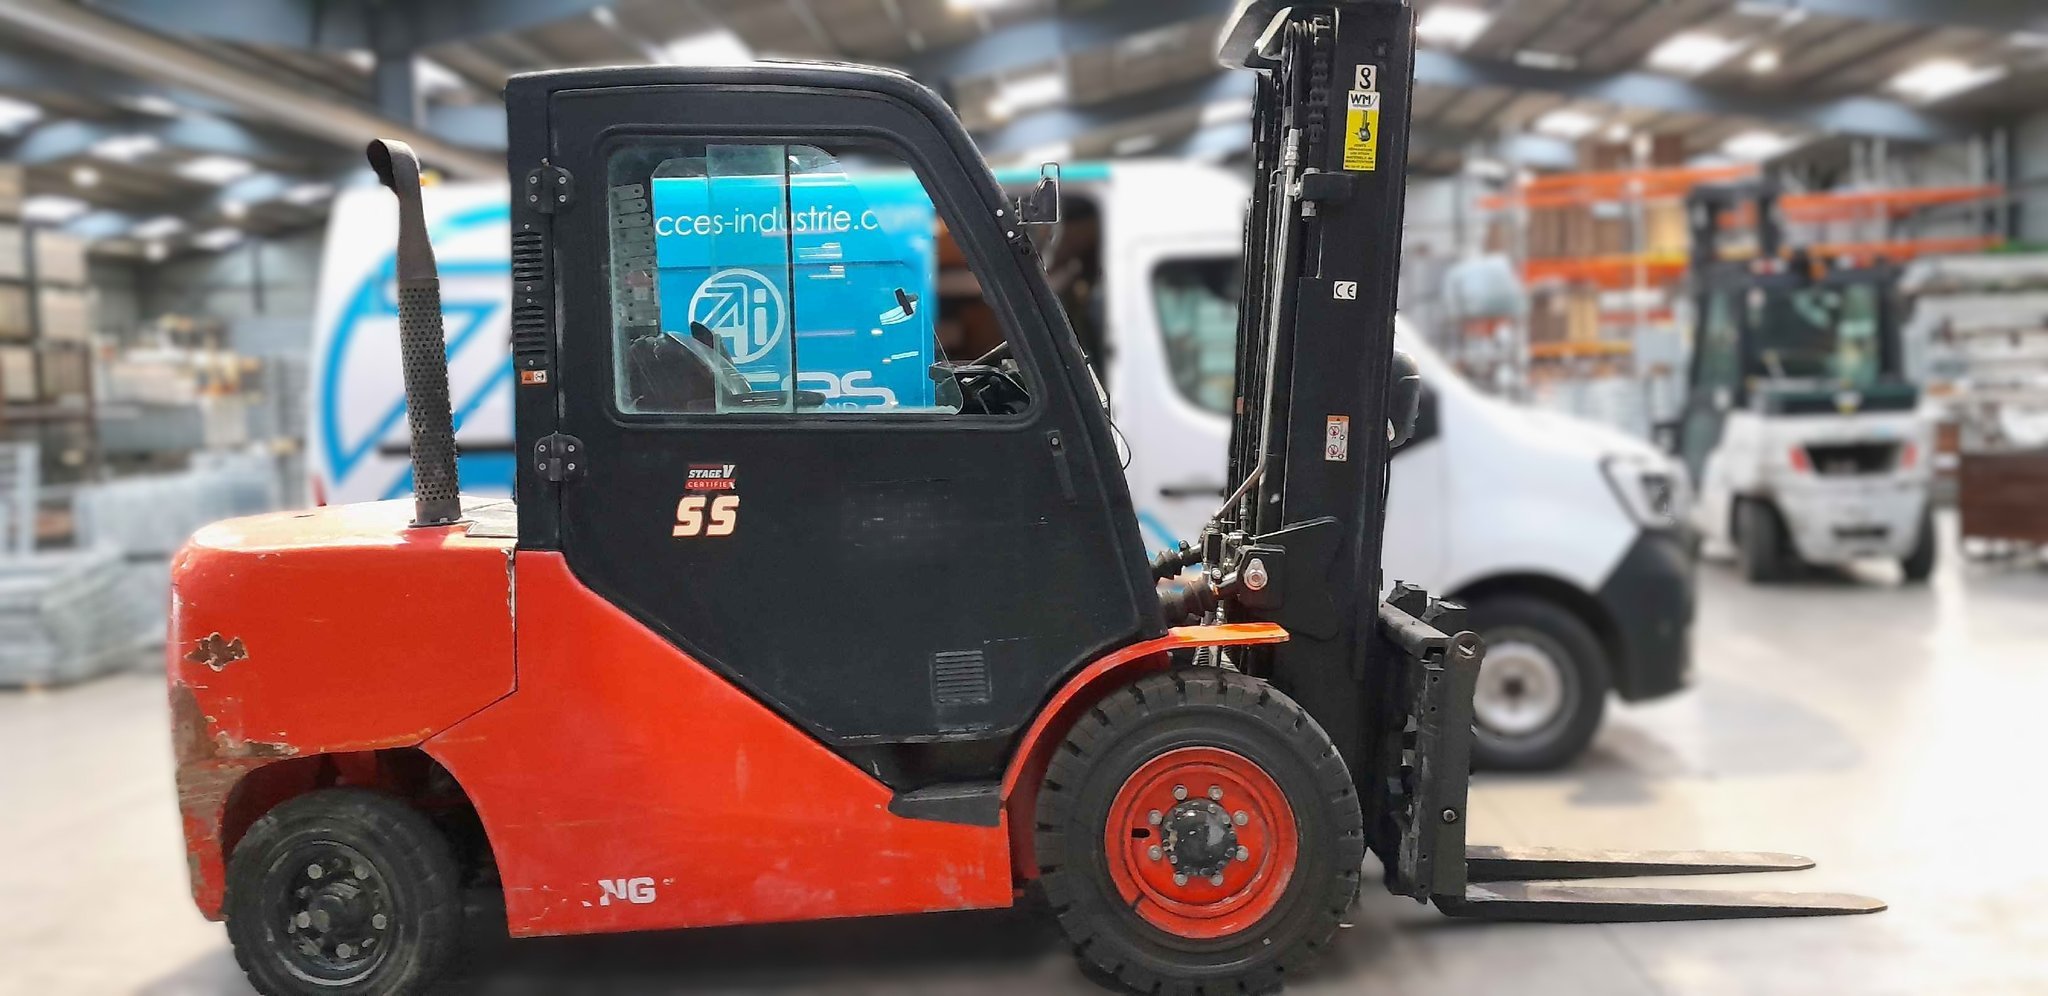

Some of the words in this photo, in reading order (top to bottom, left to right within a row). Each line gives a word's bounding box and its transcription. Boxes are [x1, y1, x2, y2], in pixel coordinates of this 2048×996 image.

[655, 204, 928, 237] cces-industrie.c
[688, 469, 722, 478] STAGE
[722, 464, 735, 478] V
